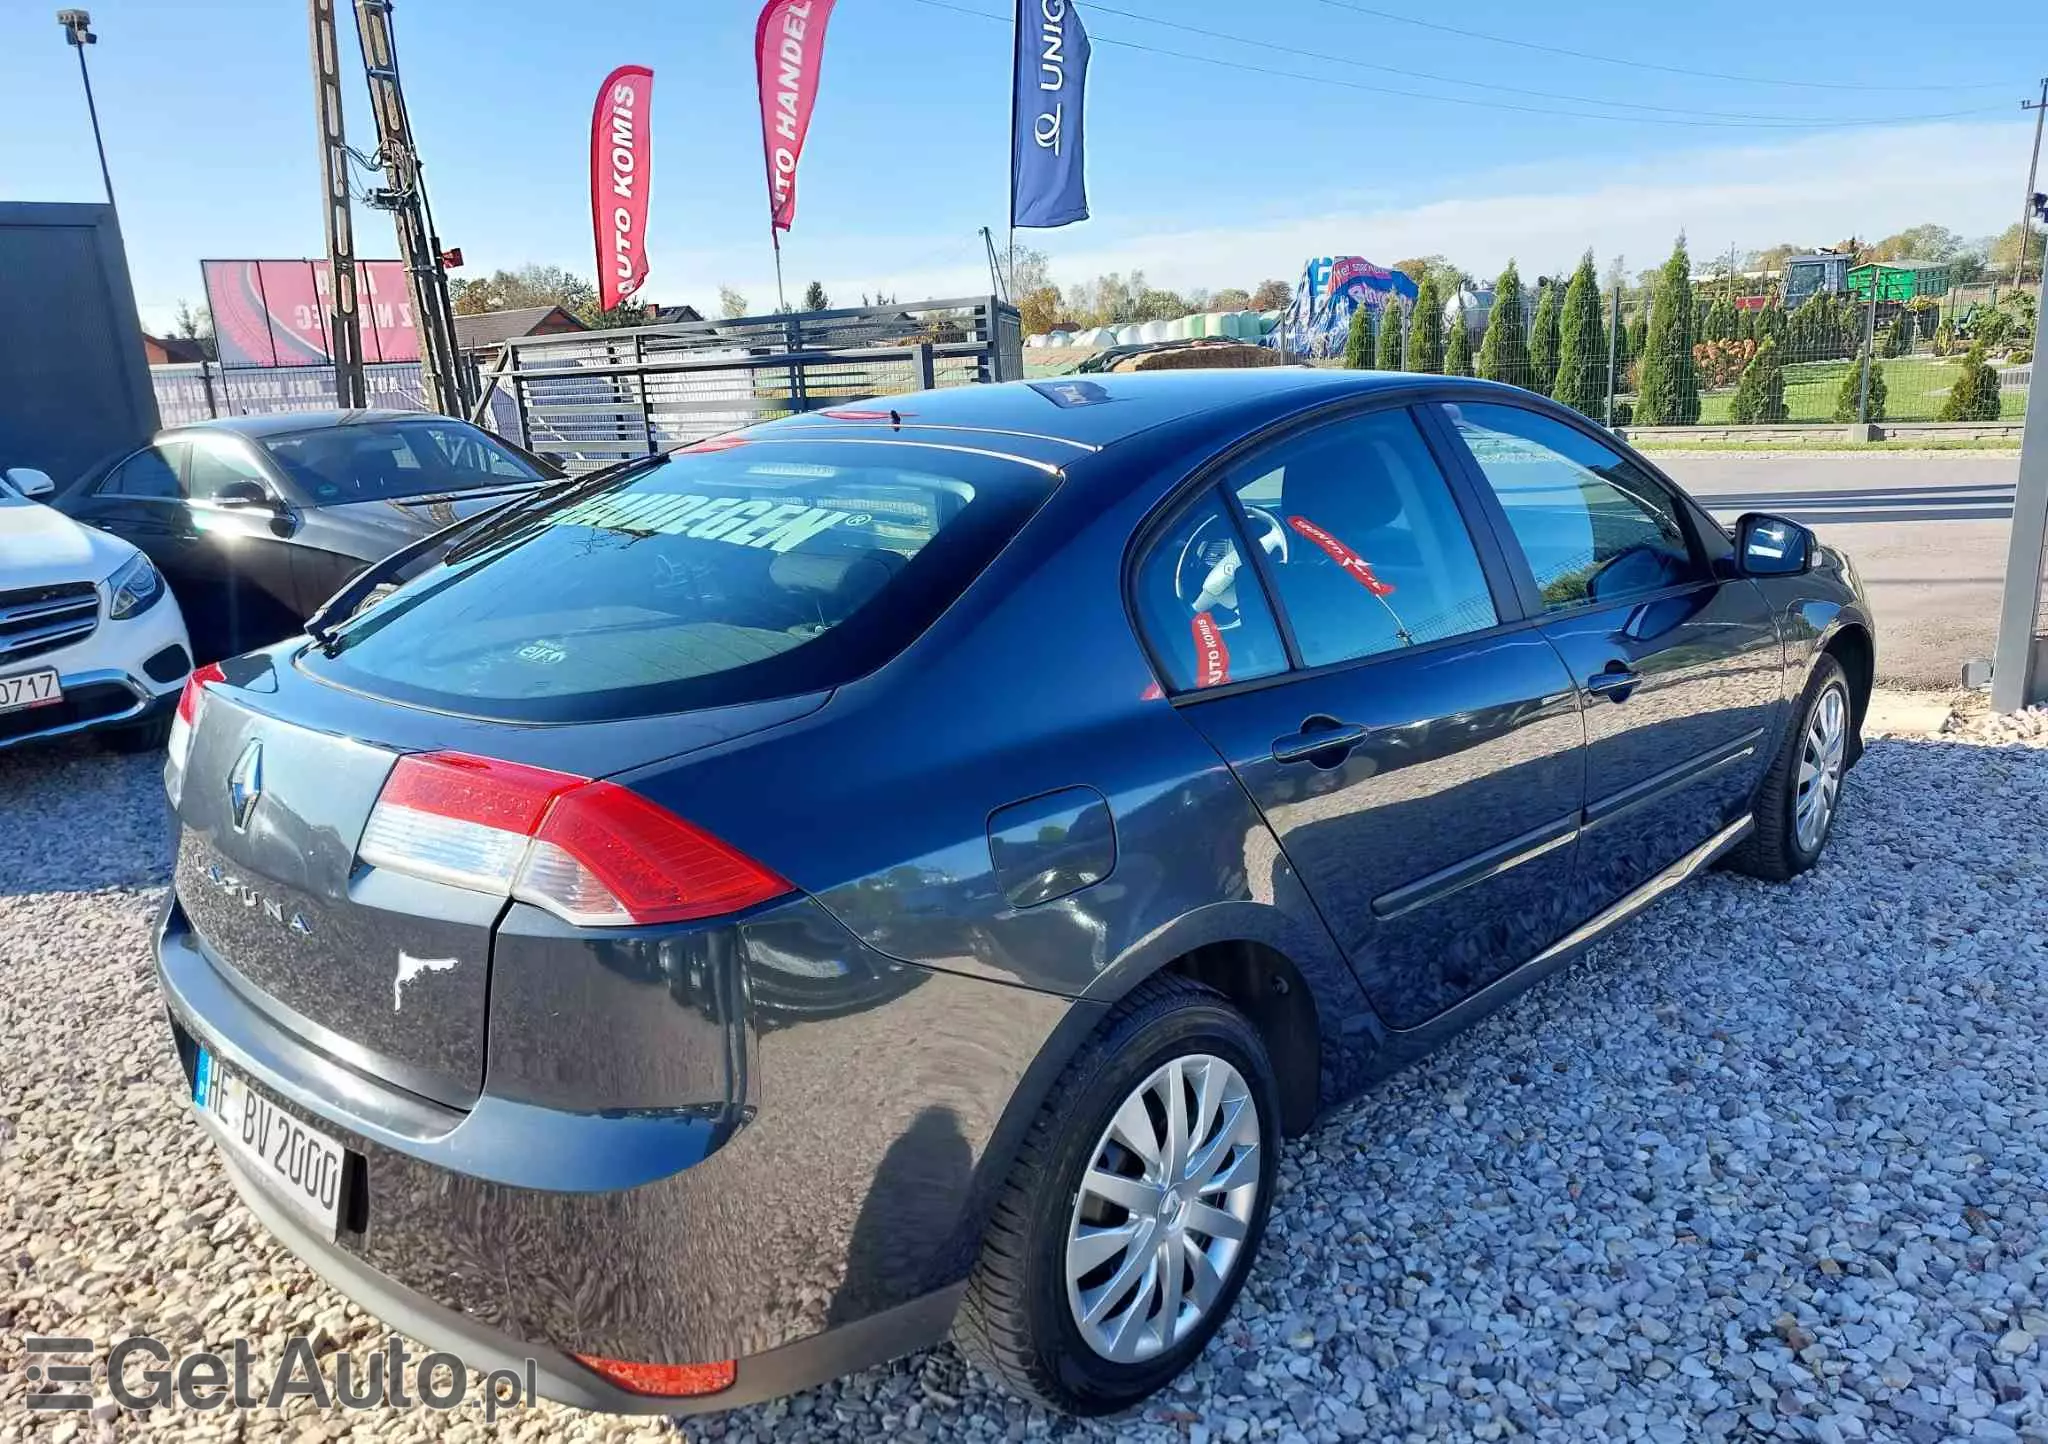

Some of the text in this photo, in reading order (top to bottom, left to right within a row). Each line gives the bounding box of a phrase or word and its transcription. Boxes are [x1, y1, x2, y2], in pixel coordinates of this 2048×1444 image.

[611, 83, 635, 199] KOMIS
[775, 0, 813, 141] HANDEL
[207, 1056, 338, 1211] HE BV 2000
